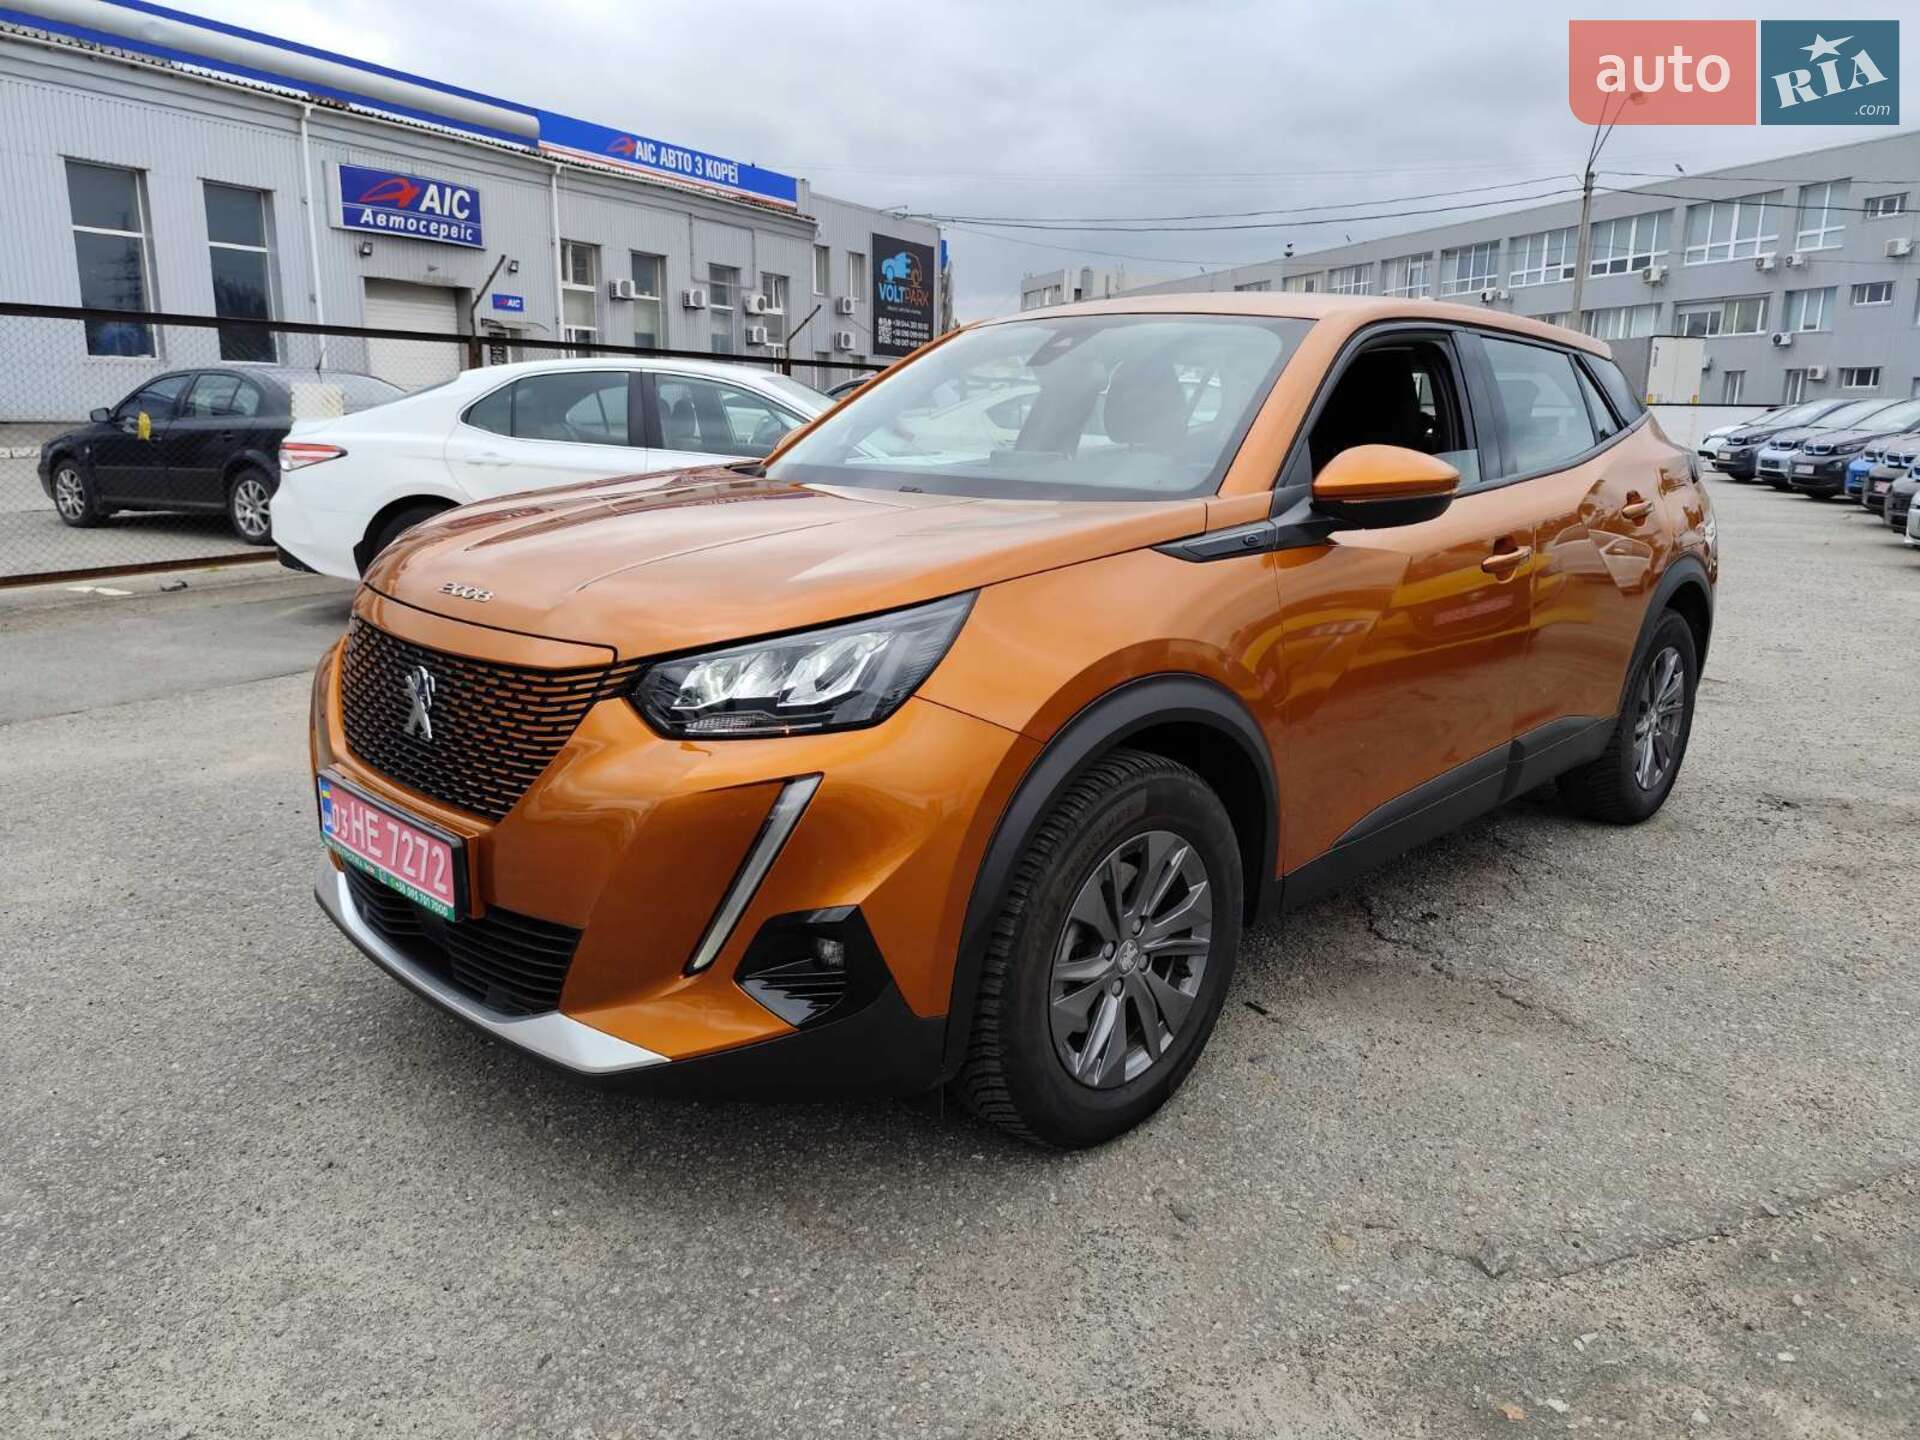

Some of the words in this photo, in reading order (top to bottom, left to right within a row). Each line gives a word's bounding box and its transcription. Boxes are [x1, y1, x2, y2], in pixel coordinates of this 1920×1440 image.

[660, 146, 692, 173] АВТО
[705, 158, 739, 185] КОРЕЇ
[360, 208, 474, 241] Автосервіс
[878, 281, 930, 307] VOLTPARK
[437, 581, 495, 603] 2008
[387, 821, 448, 895] 7272
